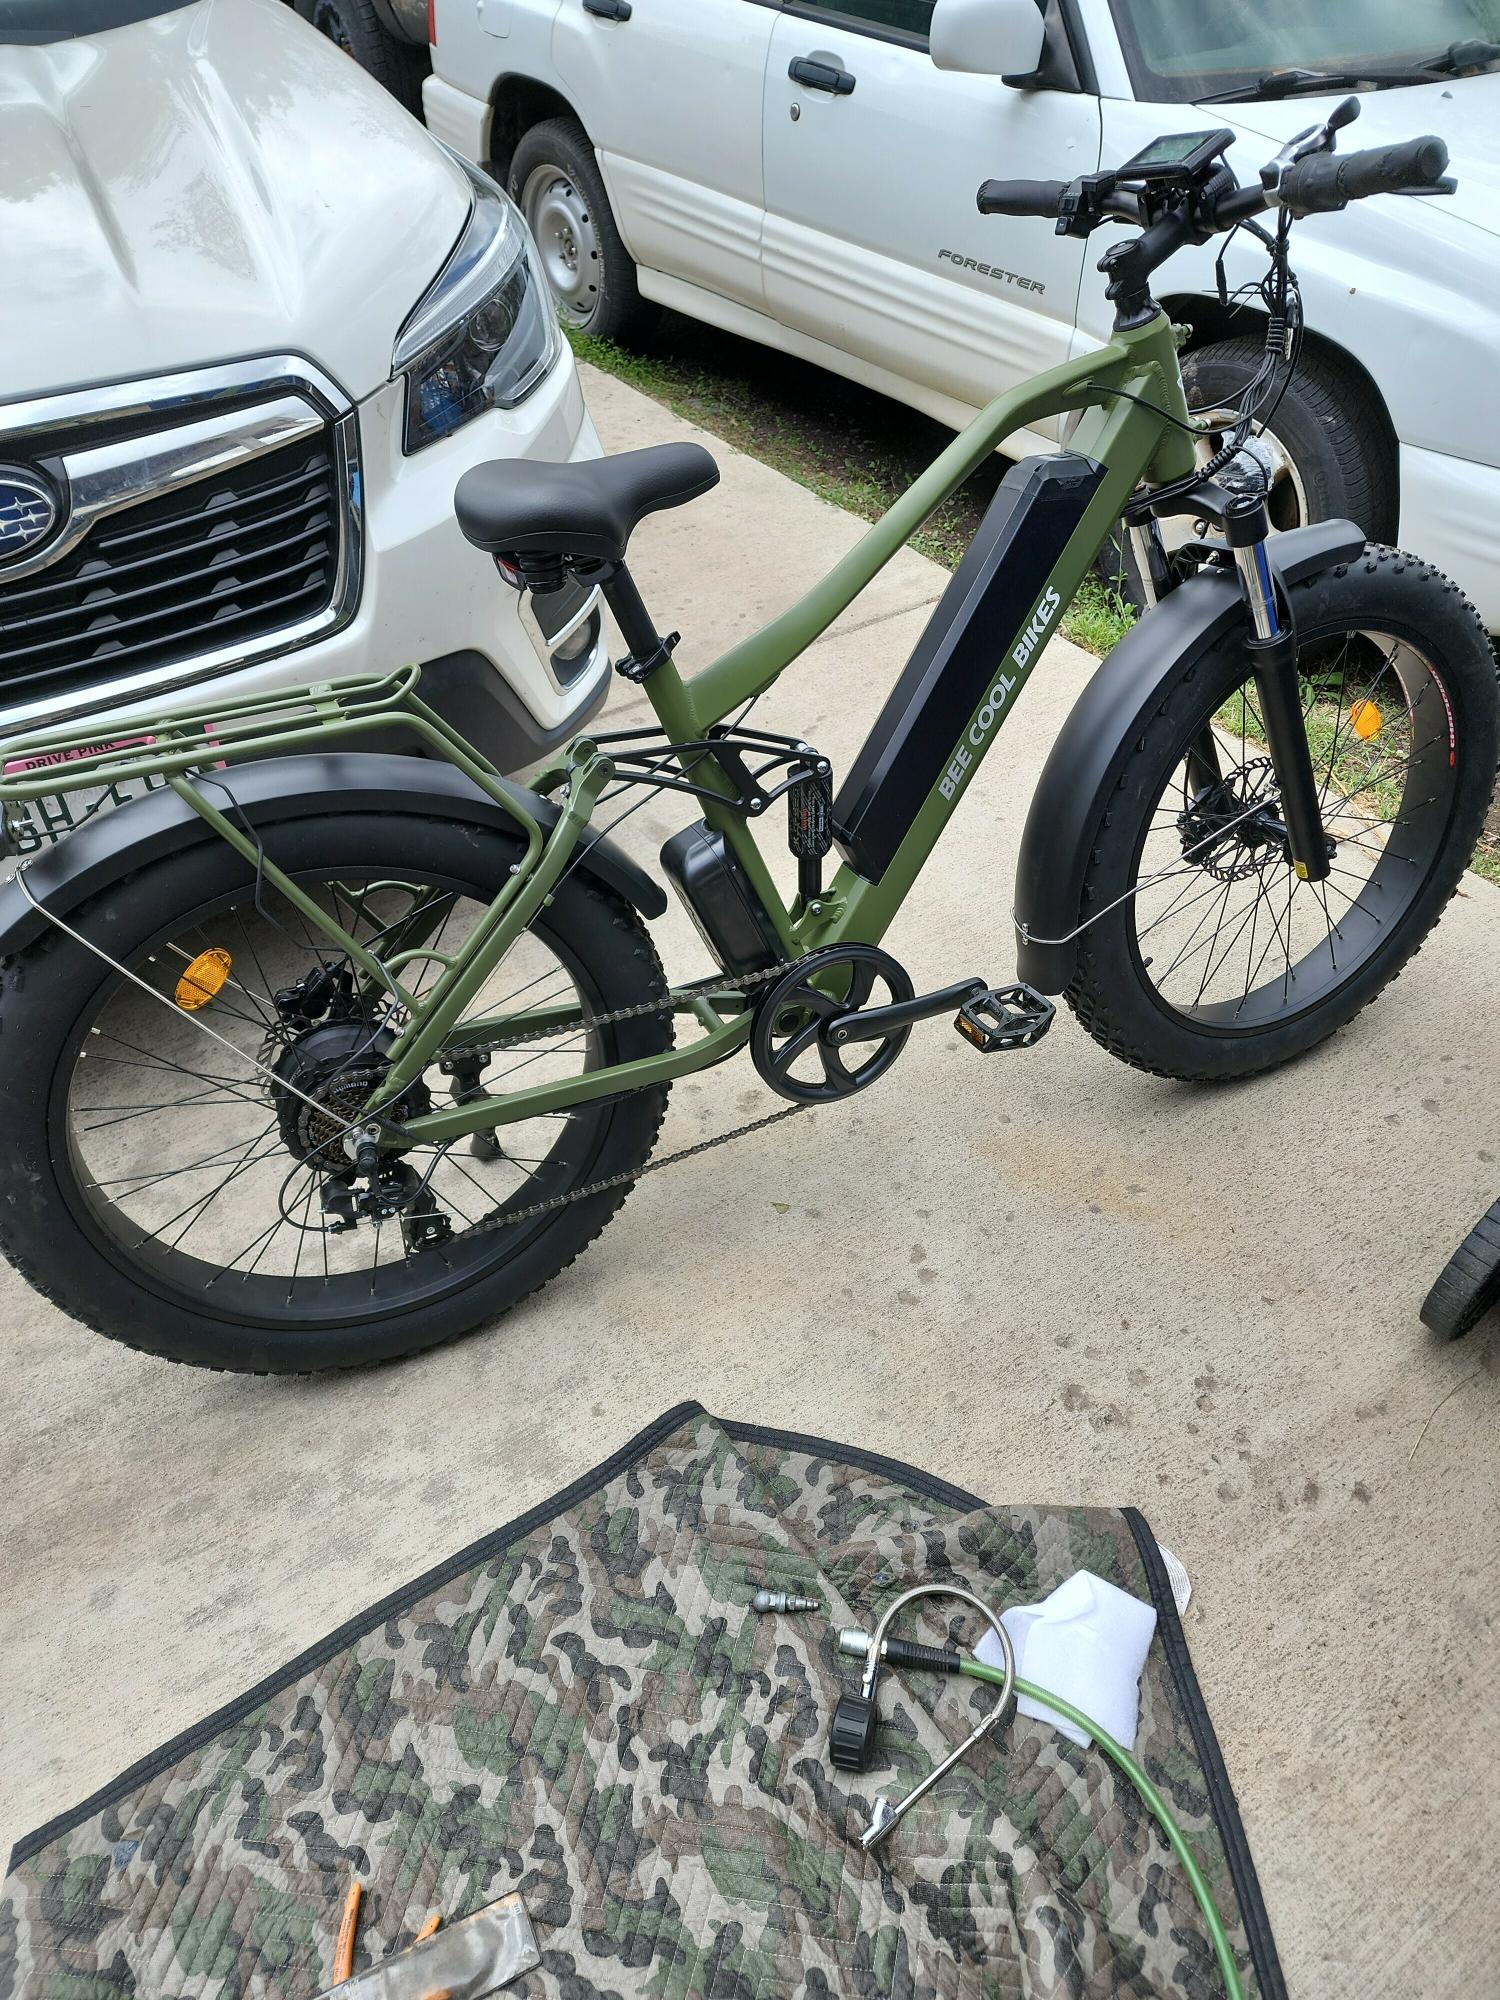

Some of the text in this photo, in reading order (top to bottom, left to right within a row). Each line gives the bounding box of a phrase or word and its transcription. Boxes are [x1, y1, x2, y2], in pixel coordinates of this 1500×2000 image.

[938, 249, 1046, 295] FORESTER
[938, 586, 1061, 801] BEE COOL BIKES
[25, 750, 74, 770] DRIVE
